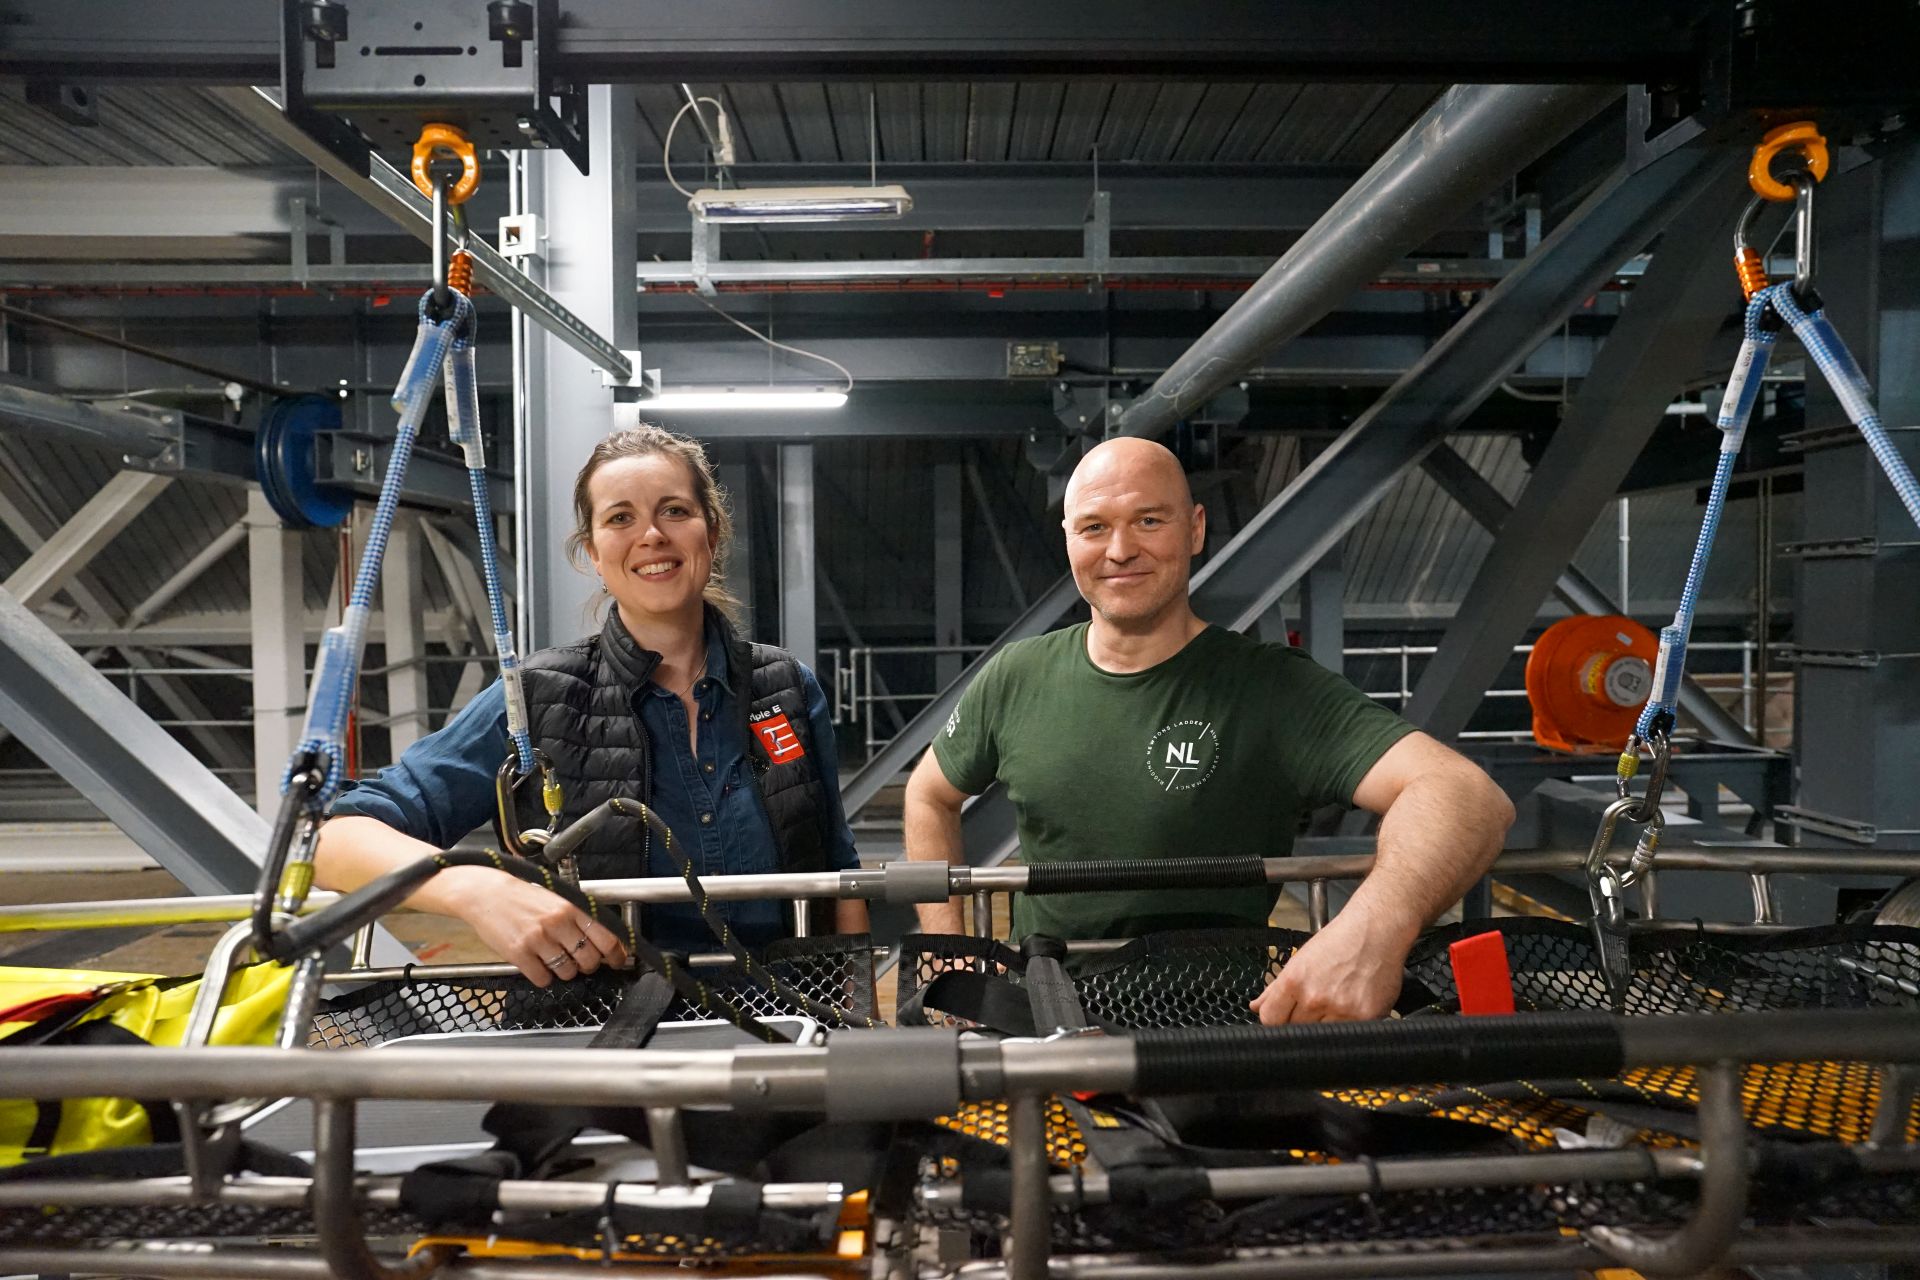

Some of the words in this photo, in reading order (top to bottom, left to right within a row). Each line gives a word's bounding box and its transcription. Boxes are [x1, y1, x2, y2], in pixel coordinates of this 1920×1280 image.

[772, 704, 781, 713] E
[1146, 725, 1171, 755] NEWTONS
[1174, 720, 1203, 728] LADDER
[1166, 742, 1199, 764] NL
